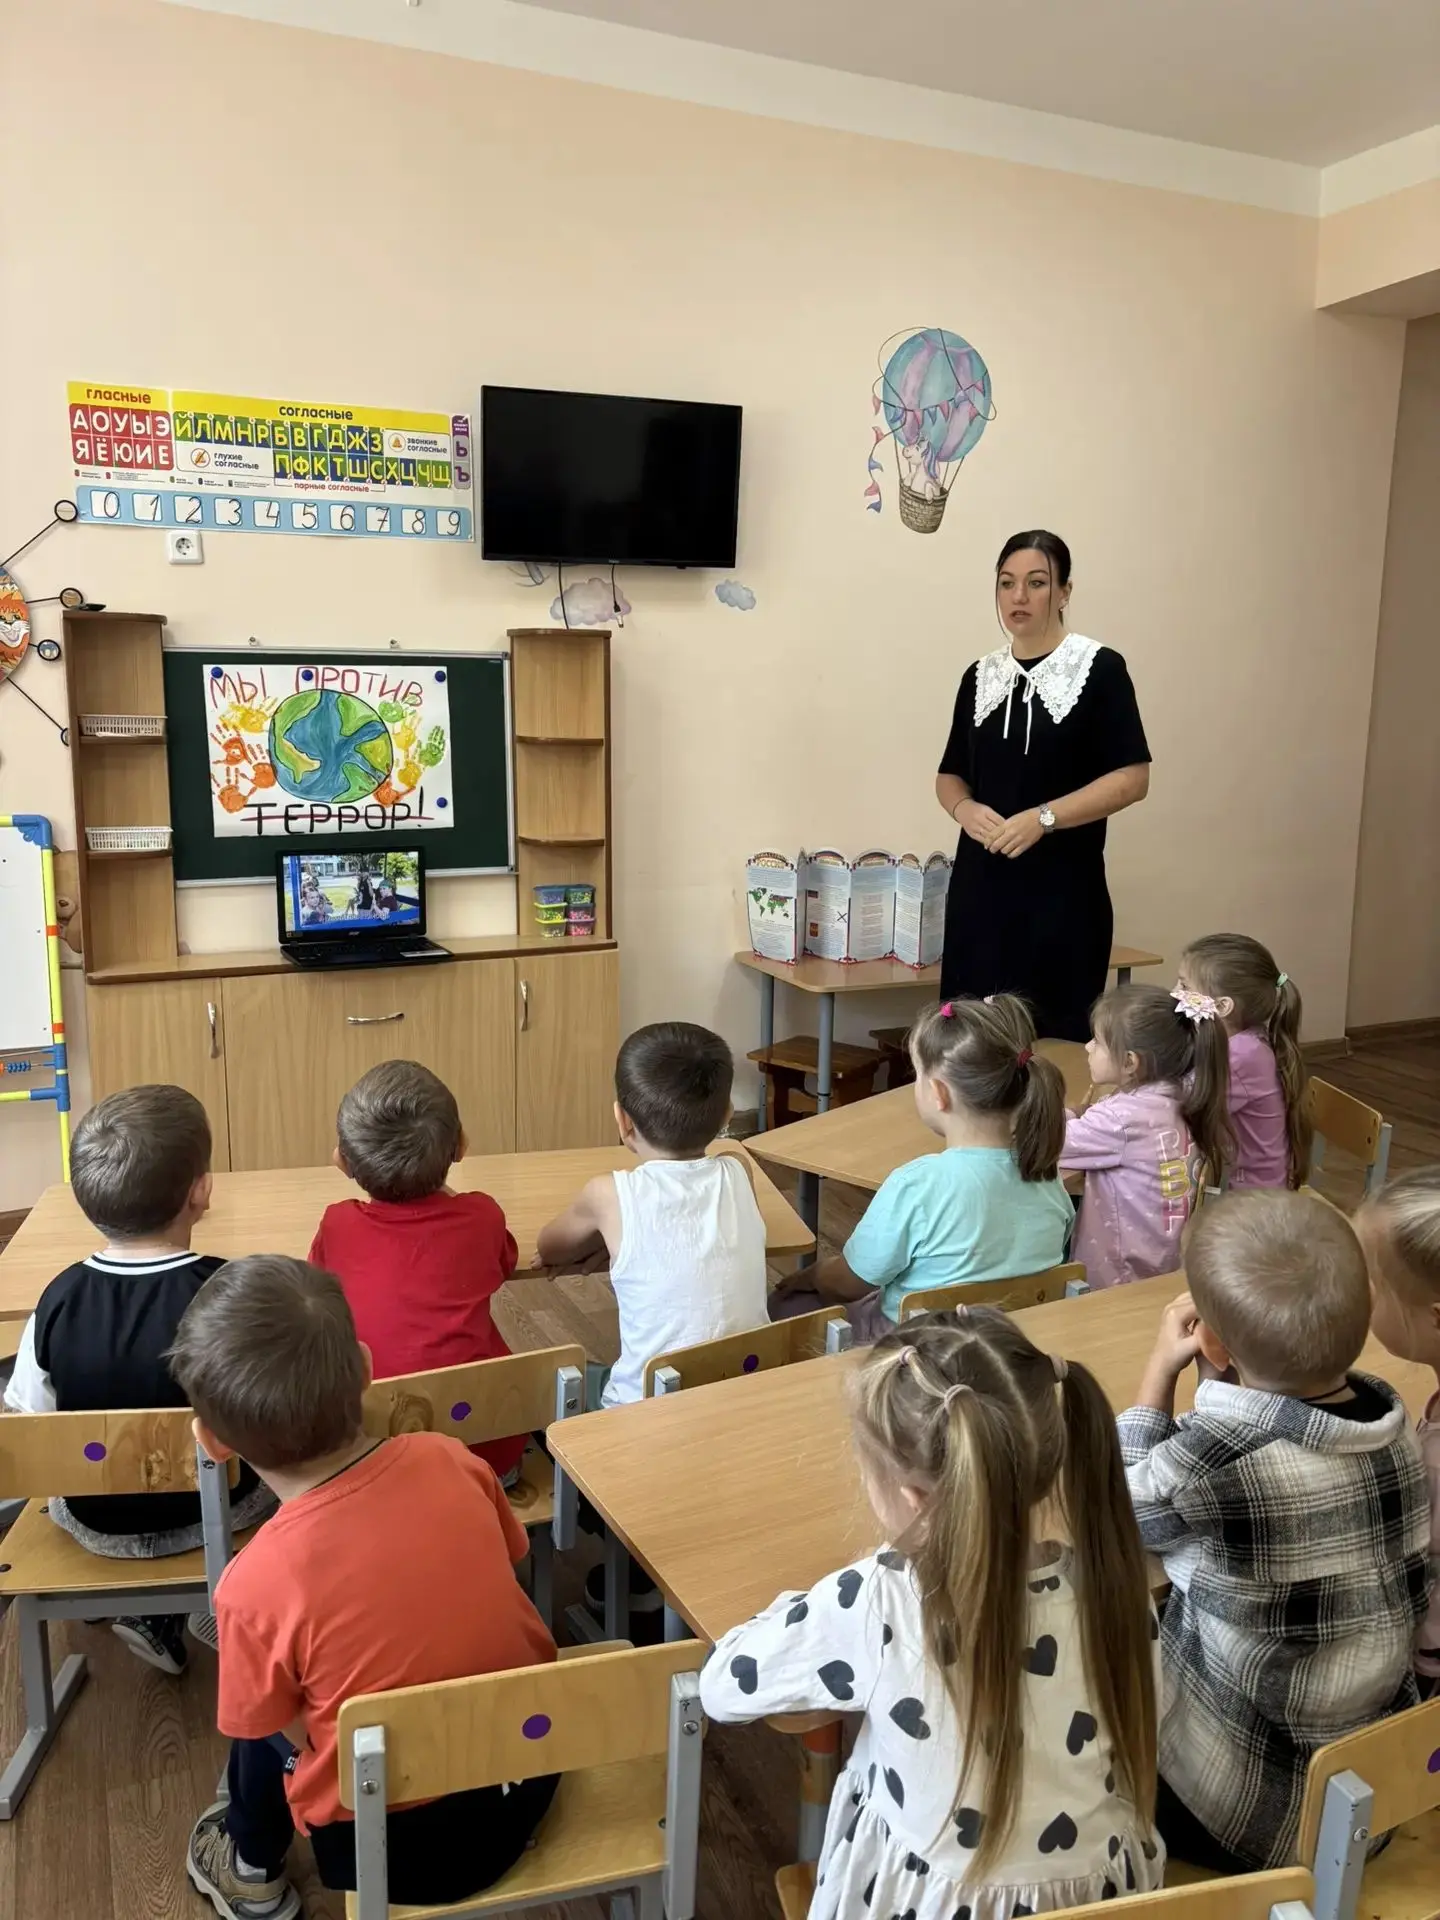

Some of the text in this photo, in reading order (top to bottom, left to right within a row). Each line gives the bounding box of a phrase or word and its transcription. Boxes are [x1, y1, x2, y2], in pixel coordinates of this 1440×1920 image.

[86, 388, 151, 404] гласные
[279, 405, 353, 421] согласные
[406, 437, 438, 446] звонкие
[407, 445, 447, 454] согласные
[214, 452, 243, 461] глухие
[214, 460, 259, 470] согласные
[294, 482, 370, 493] парные согласные
[104, 491, 461, 536] 0 1 2 3 4 5 6 7 8 9
[209, 665, 424, 709] МЫ ПРОТИВ
[243, 786, 425, 836] ТЕРРОР!
